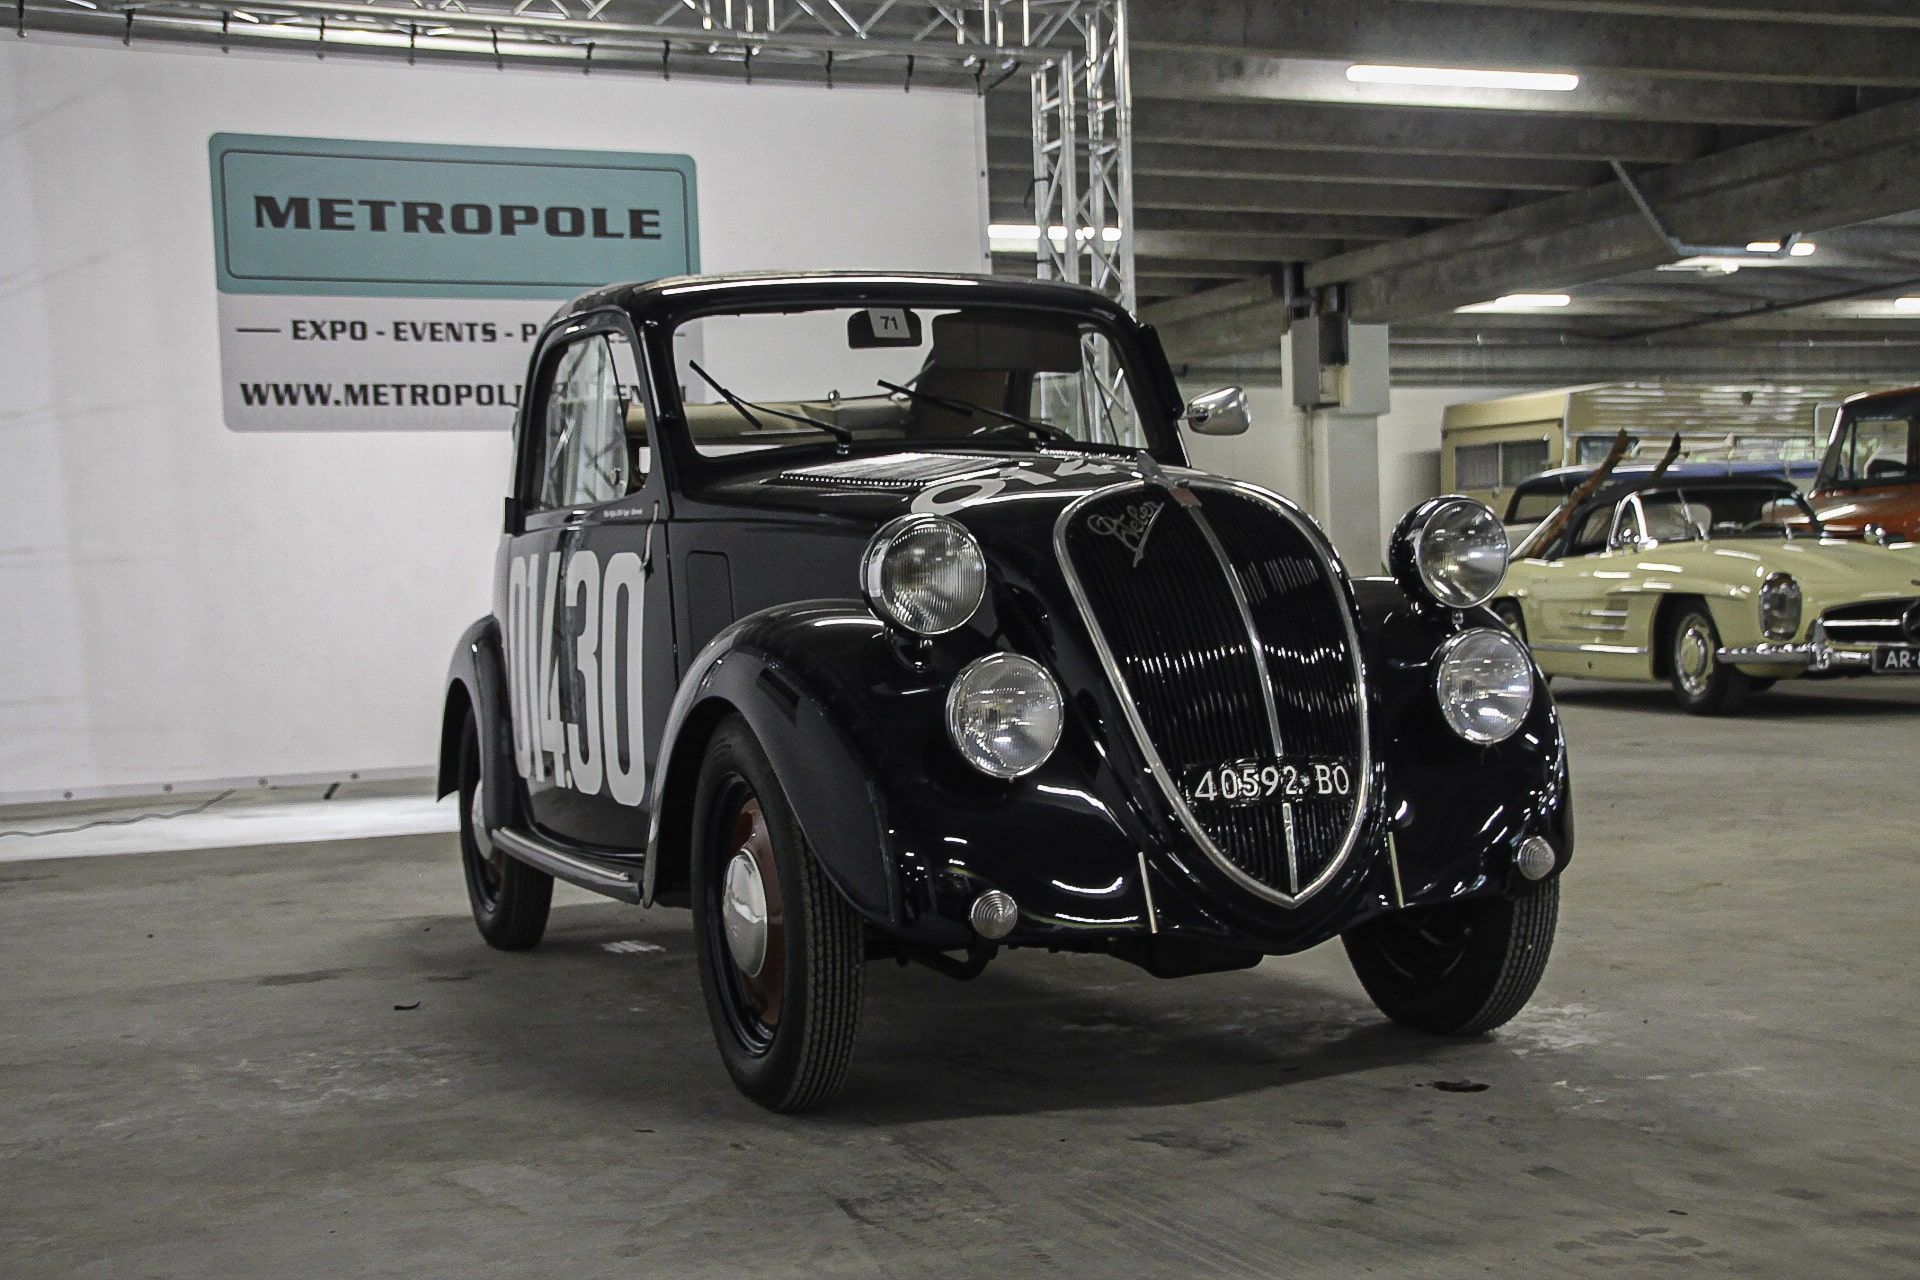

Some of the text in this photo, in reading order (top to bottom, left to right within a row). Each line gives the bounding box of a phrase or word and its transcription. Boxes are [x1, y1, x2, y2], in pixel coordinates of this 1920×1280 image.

[253, 194, 663, 241] METROPOLE
[291, 319, 368, 342] EXPO
[393, 320, 497, 344] EVENTS
[879, 315, 899, 331] 71
